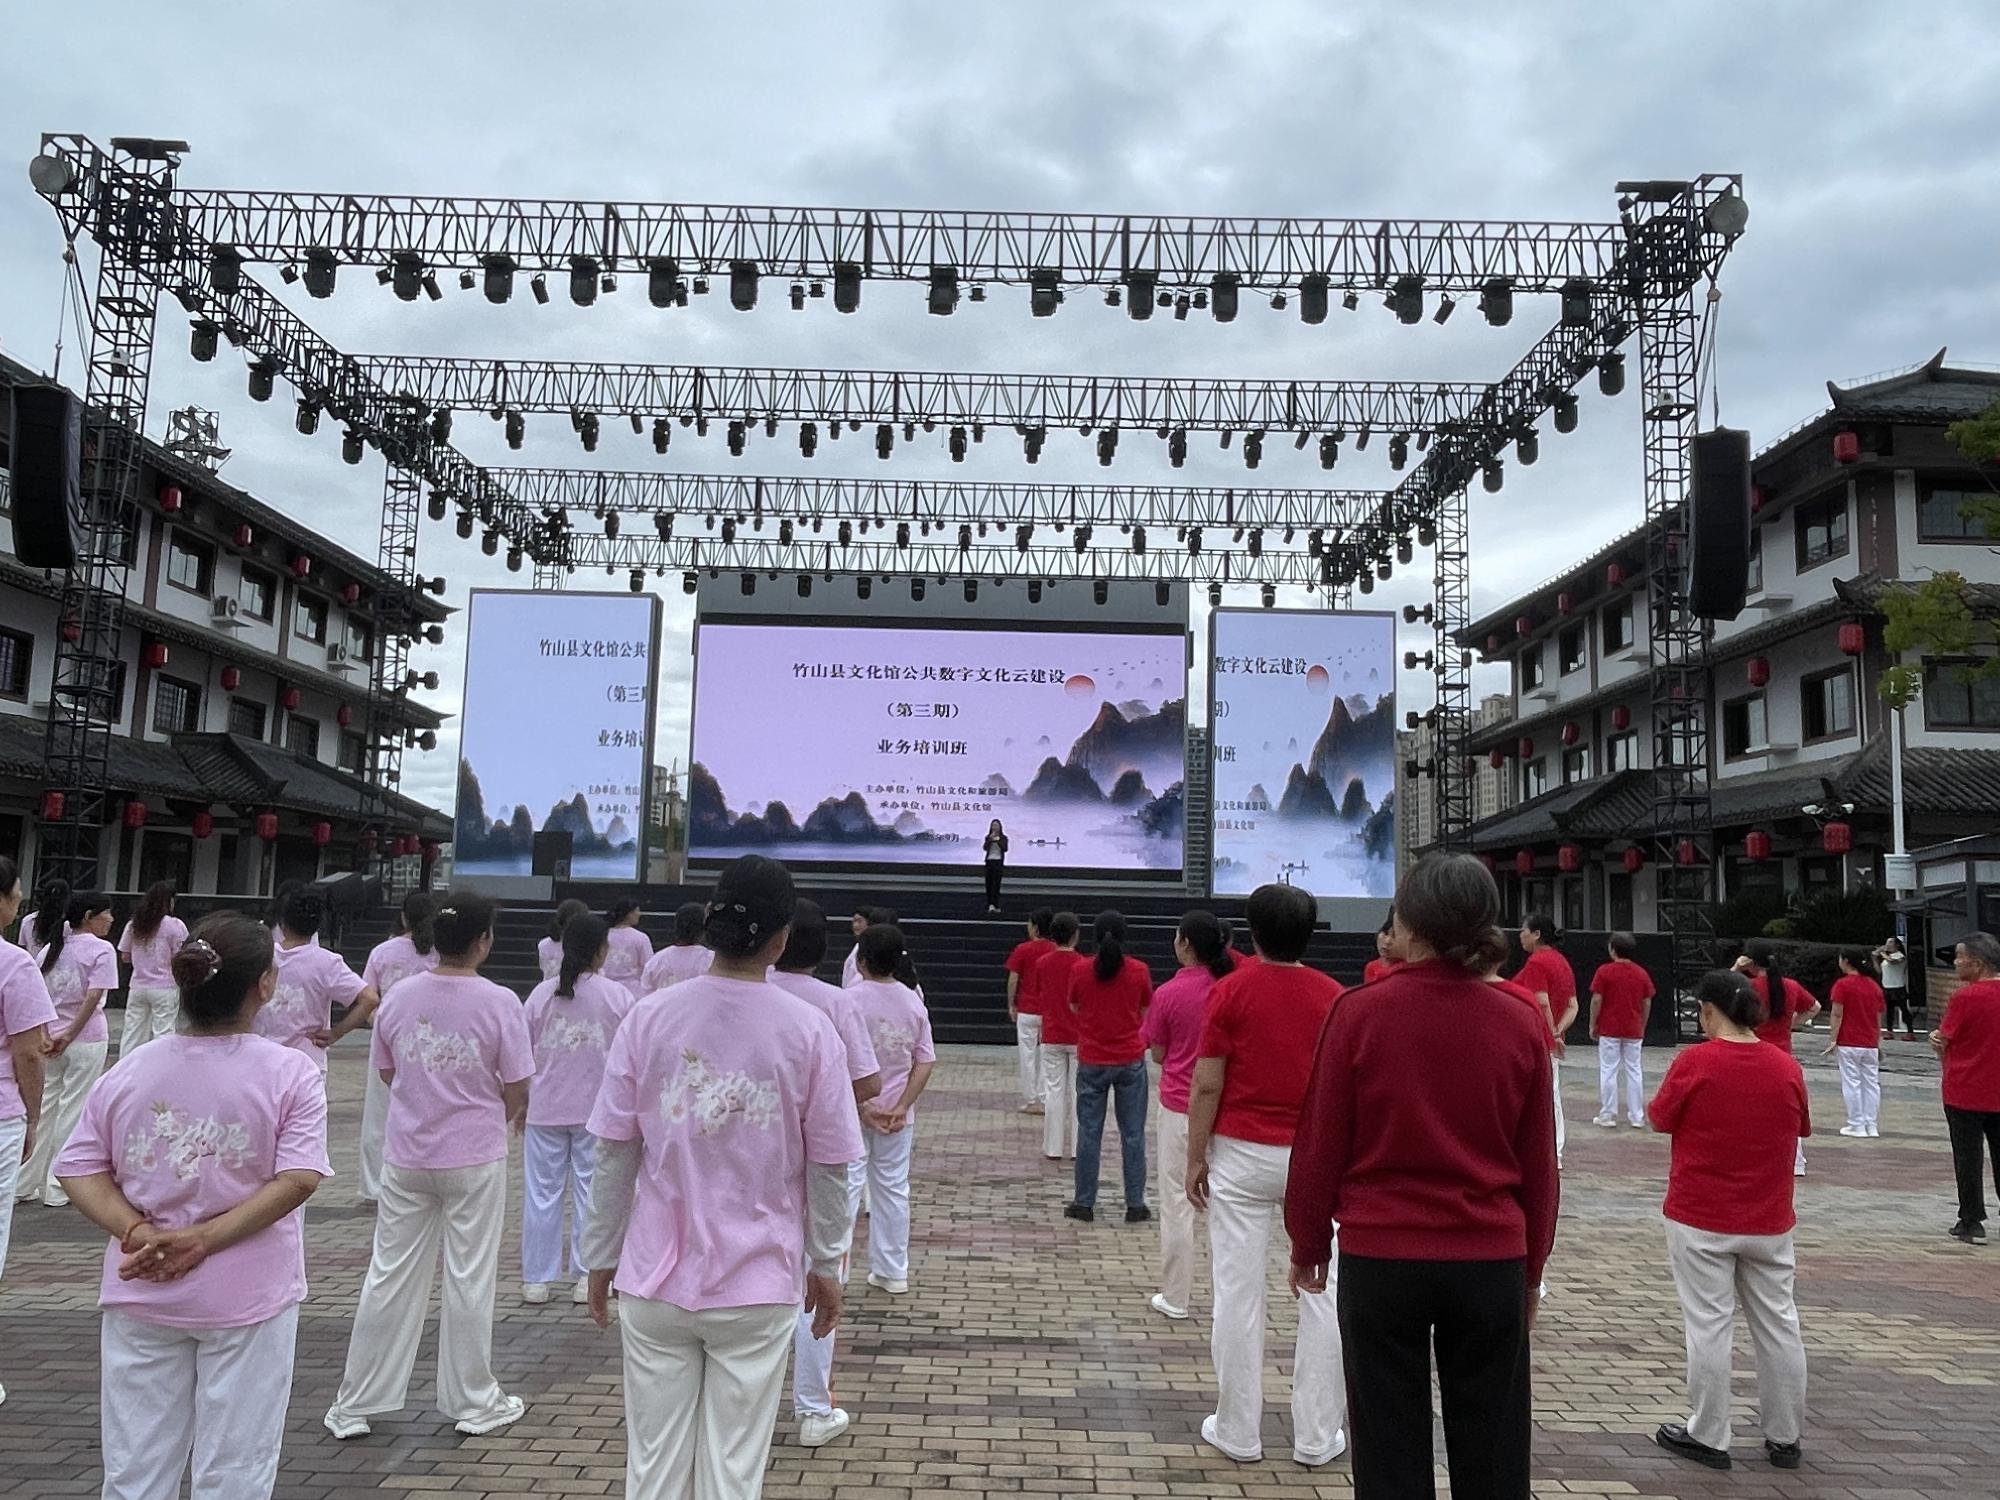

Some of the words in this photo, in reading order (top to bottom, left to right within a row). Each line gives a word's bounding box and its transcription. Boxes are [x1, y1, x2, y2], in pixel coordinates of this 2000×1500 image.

[539, 638, 646, 658] 竹山县文化馆公共
[792, 663, 1065, 684] 竹山县文化馆公共数字文化云建设
[886, 702, 960, 719] （第三期）
[876, 739, 968, 755] 业务培训班
